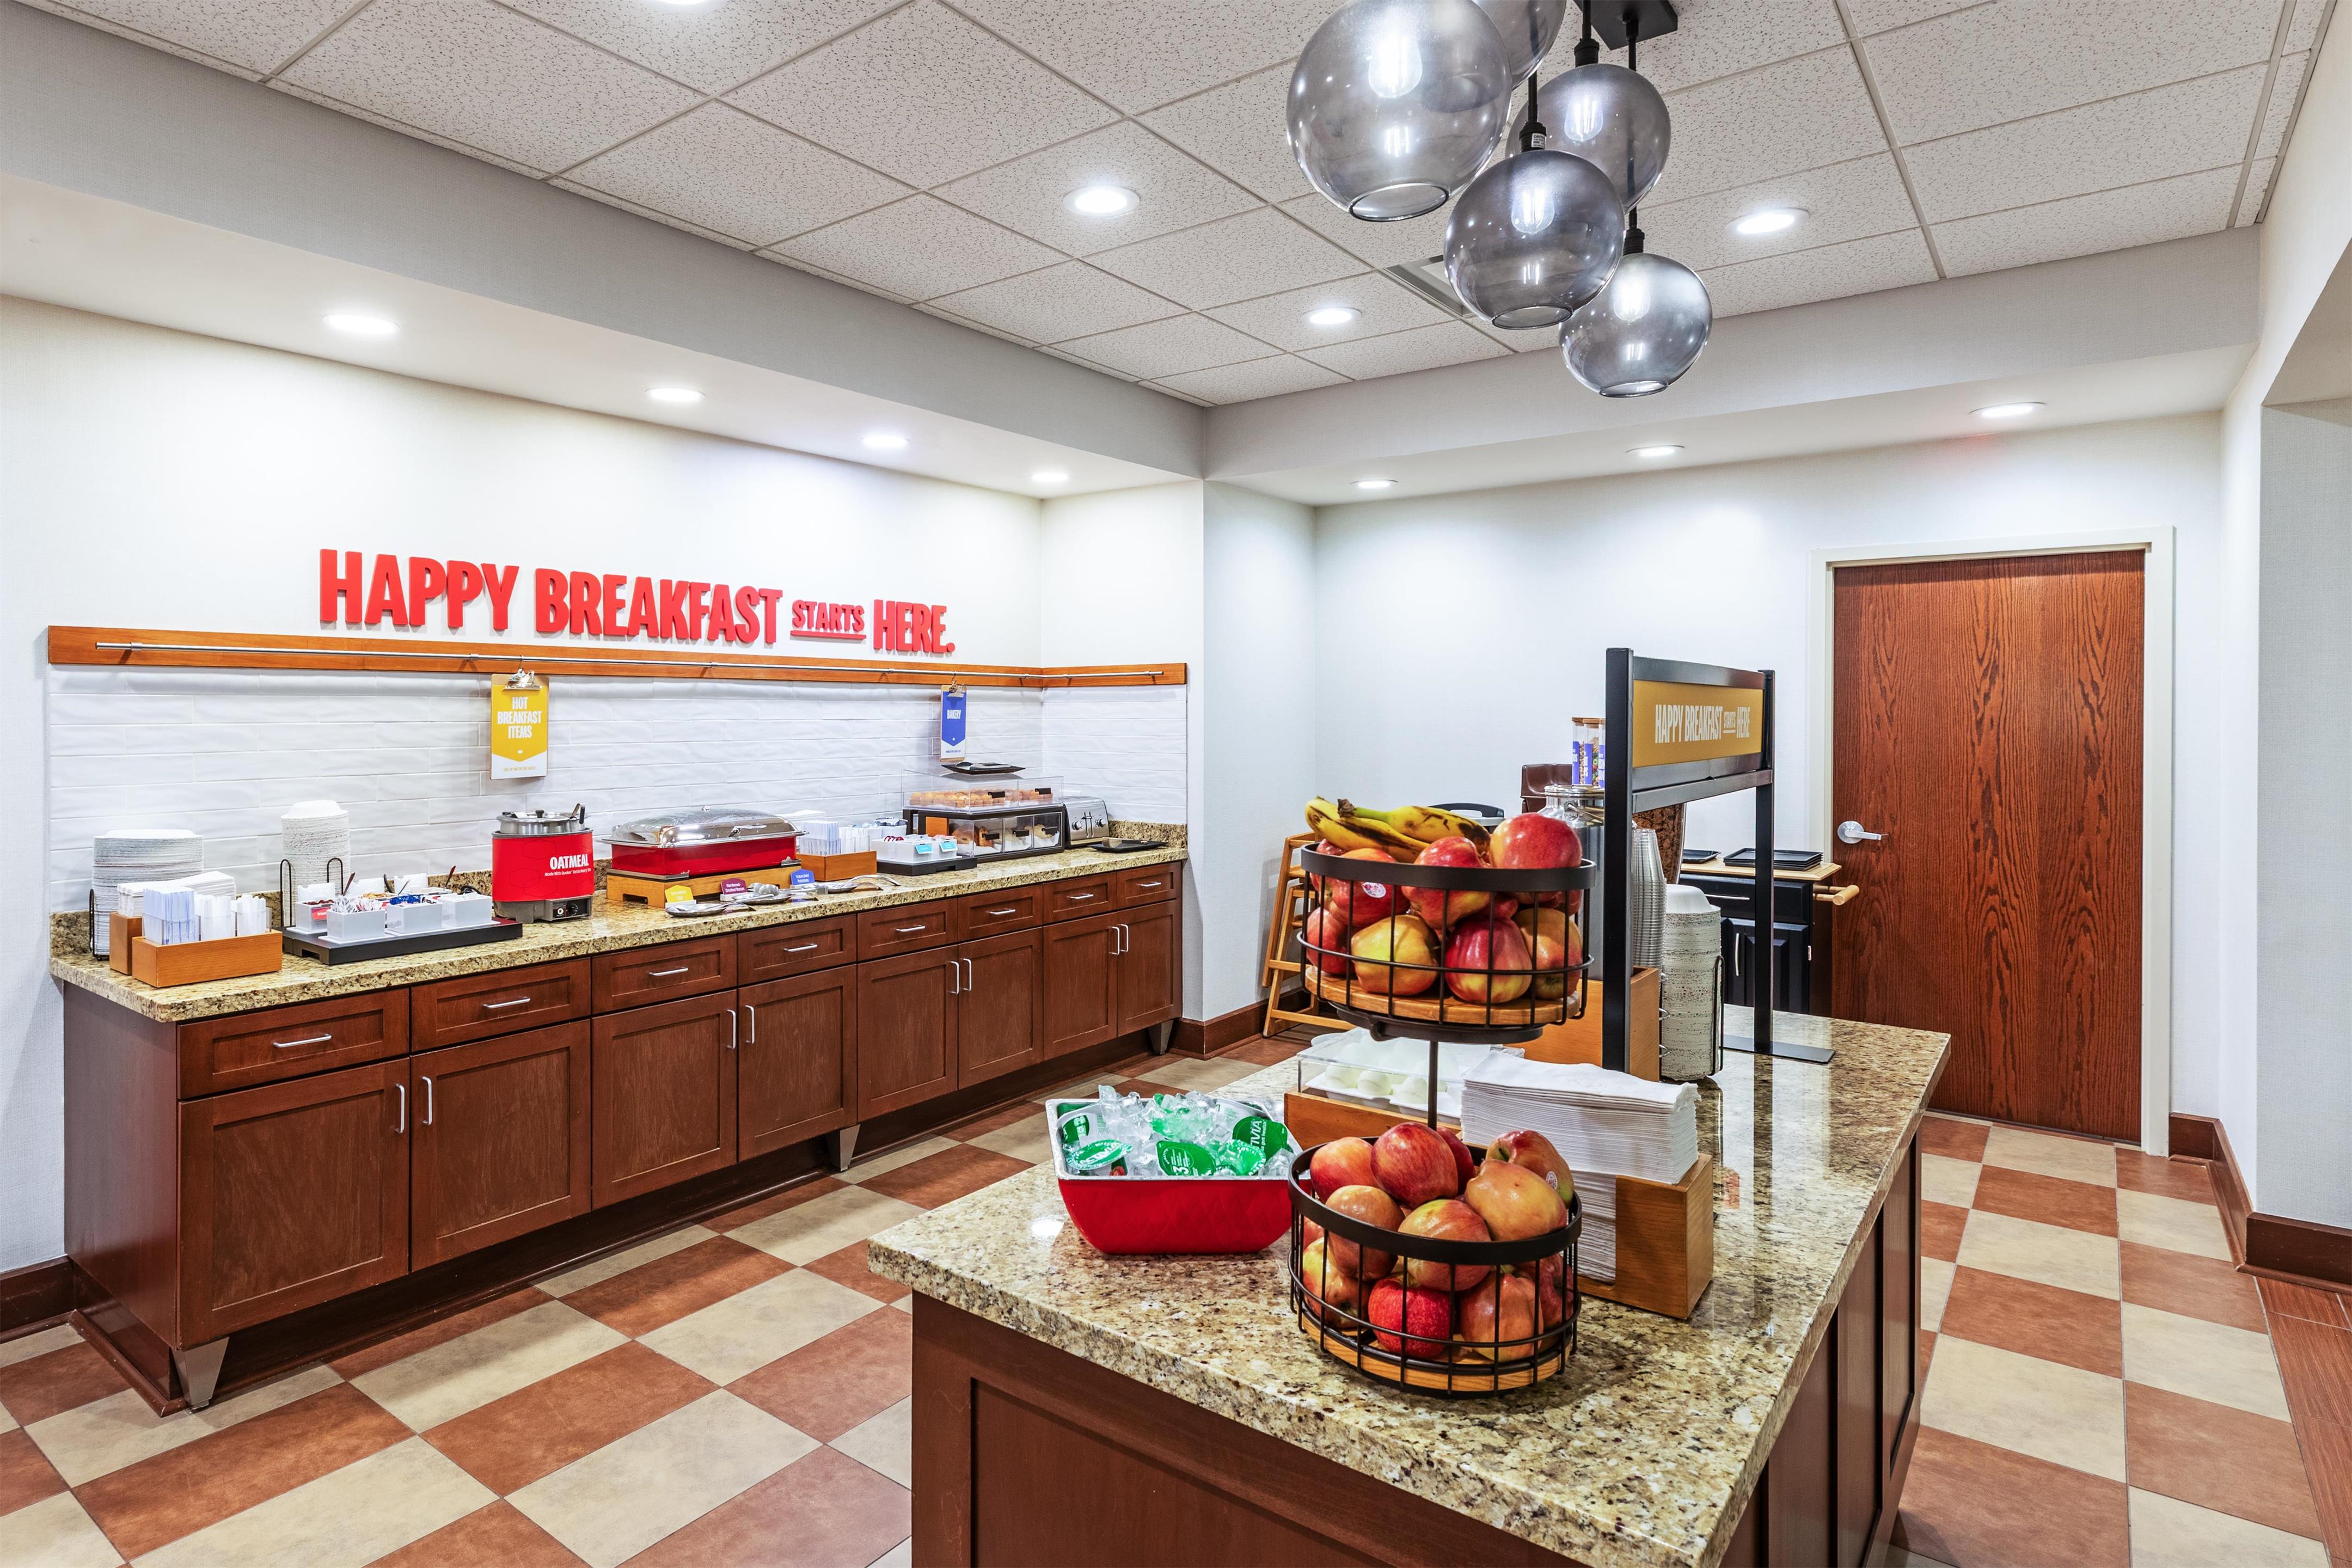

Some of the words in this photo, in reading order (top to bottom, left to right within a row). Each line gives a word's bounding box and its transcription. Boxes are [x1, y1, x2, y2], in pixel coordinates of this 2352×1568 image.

[320, 548, 520, 630] HAPPY
[535, 568, 783, 644] BREAKFAST
[792, 599, 865, 632] STARTS
[873, 599, 955, 653] HERE.
[512, 696, 529, 710] HOT
[497, 711, 542, 725] BREAKFAST
[947, 709, 961, 719] BAKERY
[507, 725, 532, 739] ITEMS
[1655, 704, 1683, 744] HAPPY
[1685, 705, 1723, 742] BREAKFAST
[1723, 711, 1736, 728] STARTS
[1736, 706, 1751, 739] HERE
[549, 853, 589, 870] OATMEAL
[1250, 1120, 1262, 1146] TIVIA
[1080, 1142, 1122, 1165] ACTIVIA
